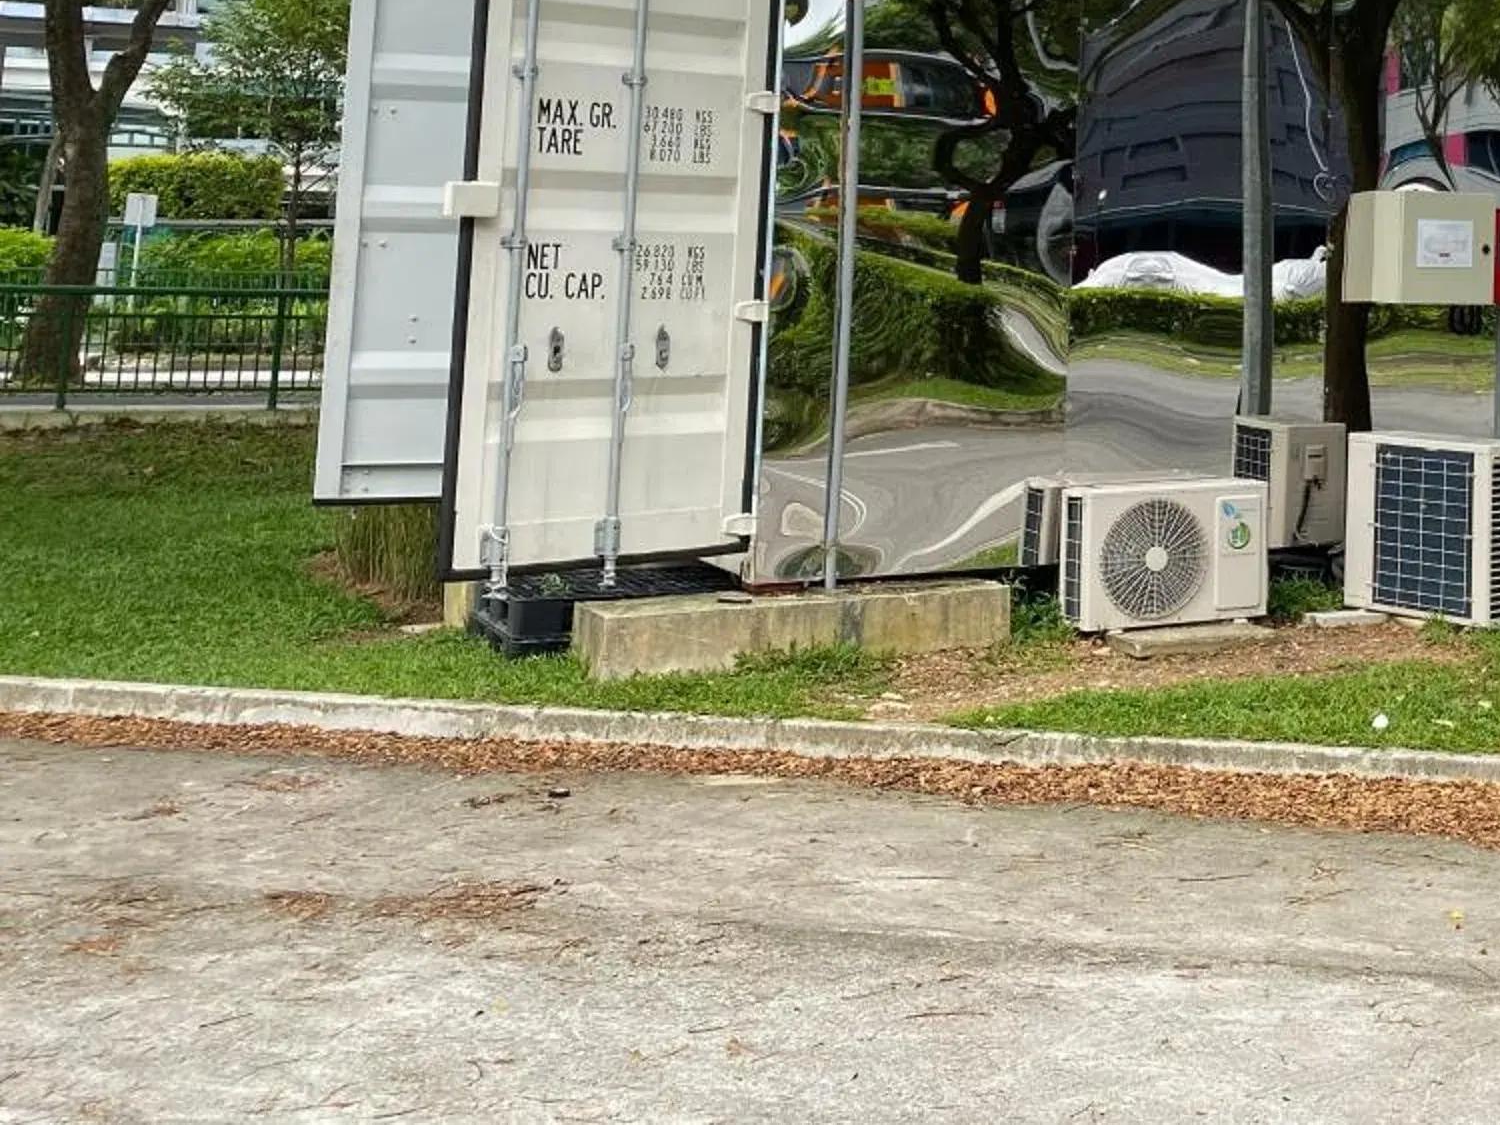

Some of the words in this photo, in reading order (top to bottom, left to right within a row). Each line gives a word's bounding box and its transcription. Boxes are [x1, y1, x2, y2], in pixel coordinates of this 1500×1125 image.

[537, 98, 583, 126] MAX.
[589, 102, 616, 129] GR.
[537, 126, 584, 155] TARE
[527, 243, 562, 270] NET
[525, 273, 554, 299] CU.
[565, 272, 605, 300] CAP.
